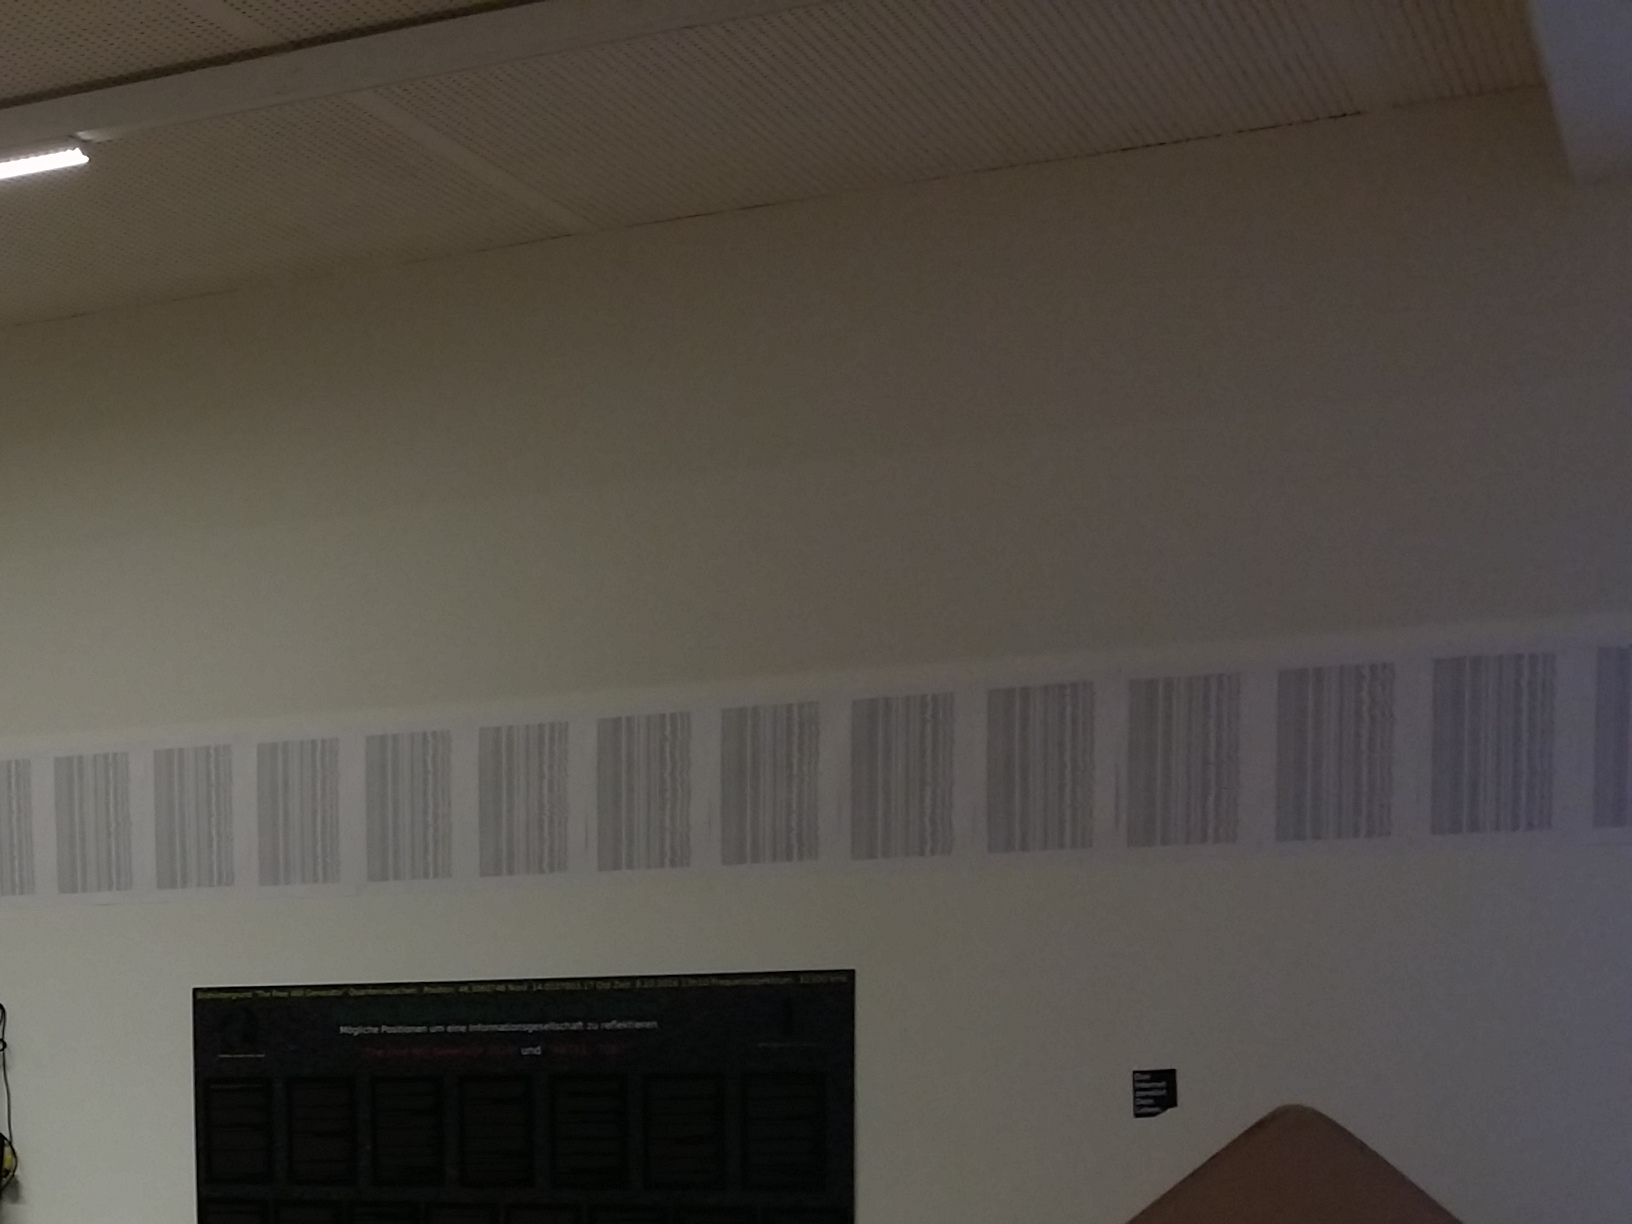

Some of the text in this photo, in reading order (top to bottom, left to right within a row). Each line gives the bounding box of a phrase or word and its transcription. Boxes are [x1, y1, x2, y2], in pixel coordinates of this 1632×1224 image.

[381, 1024, 427, 1034] Positionen
[446, 1025, 467, 1033] eine
[586, 1022, 599, 1030] zu
[520, 1045, 541, 1055] und
